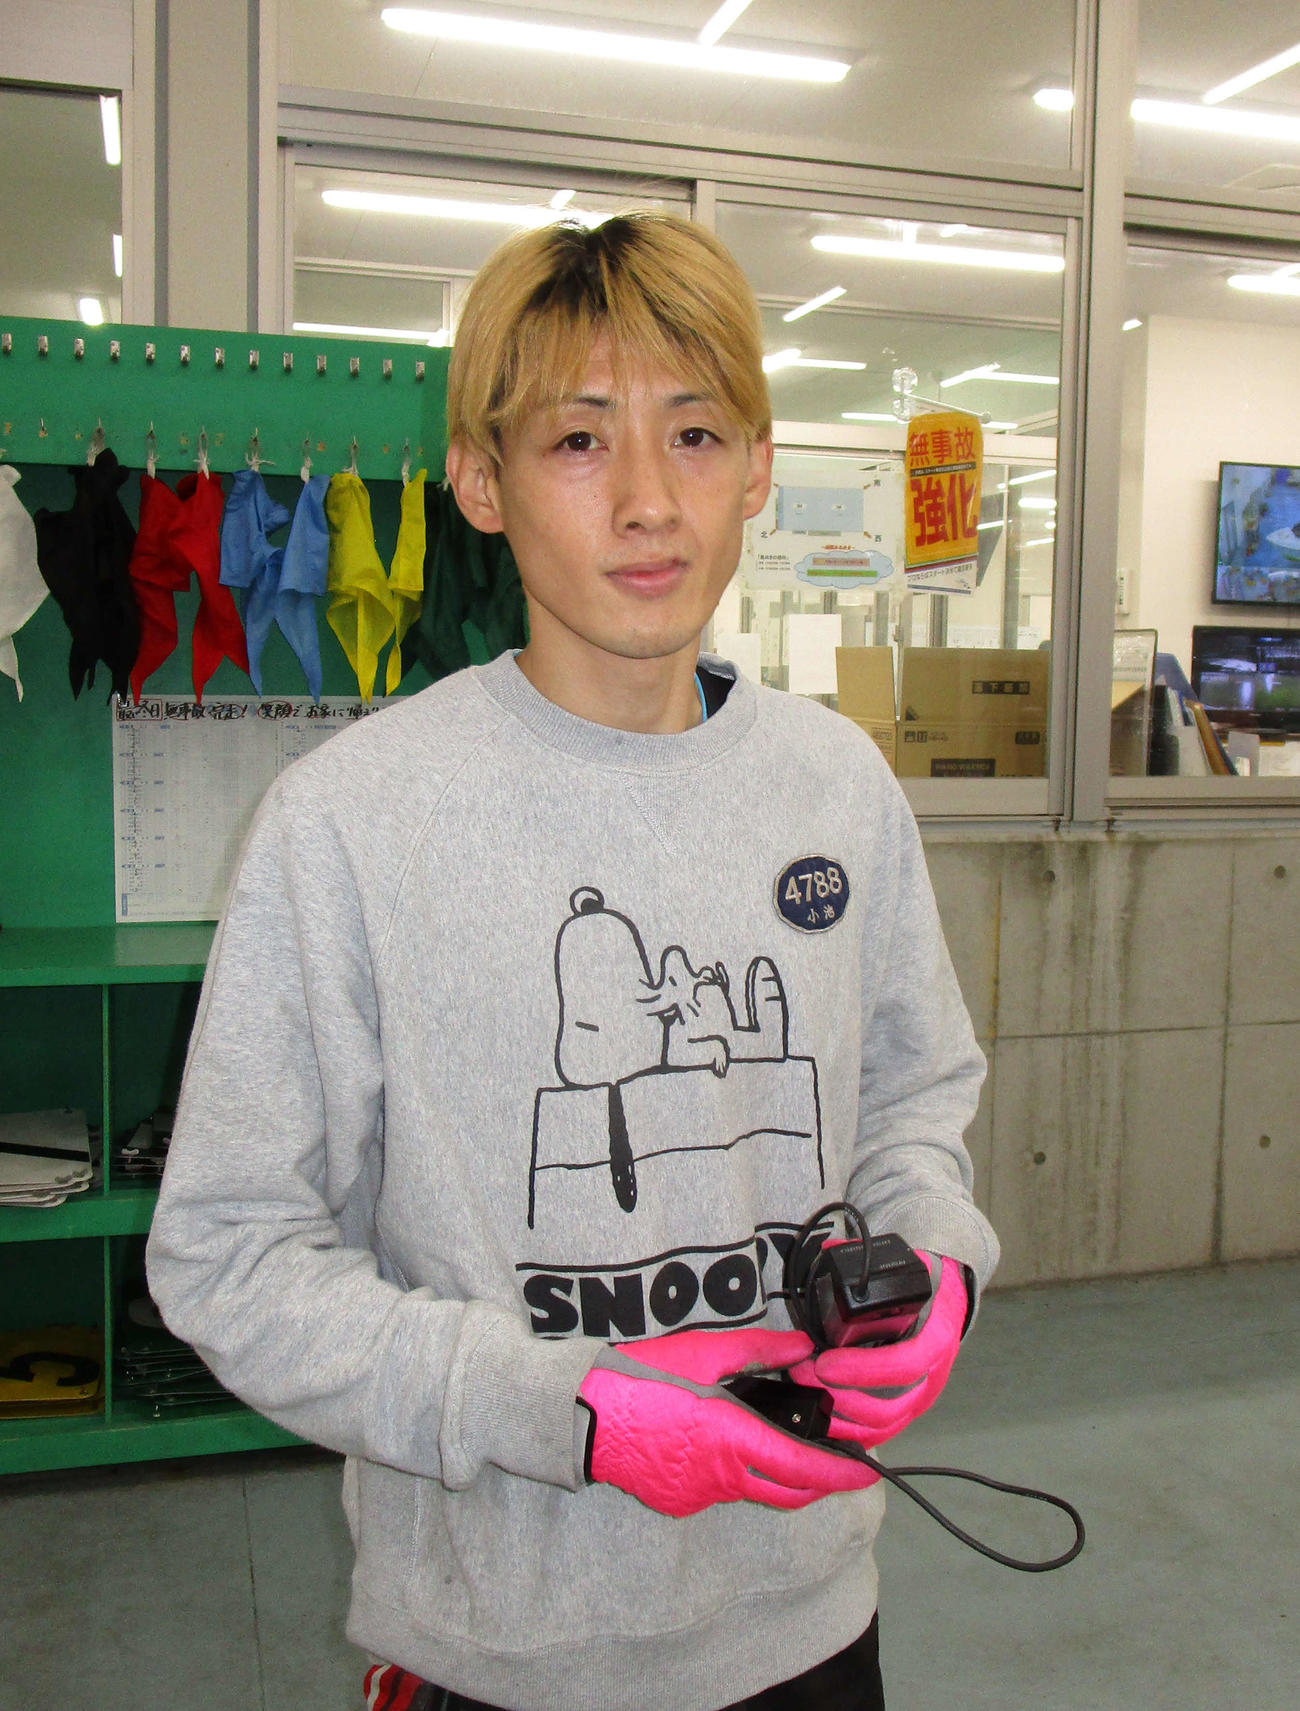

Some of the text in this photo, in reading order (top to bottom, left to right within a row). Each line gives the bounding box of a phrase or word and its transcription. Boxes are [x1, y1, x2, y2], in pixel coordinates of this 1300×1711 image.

[909, 427, 976, 467] 無事故
[910, 473, 978, 548] 強化
[785, 866, 843, 905] 4788
[523, 1231, 832, 1337] SNOOY
